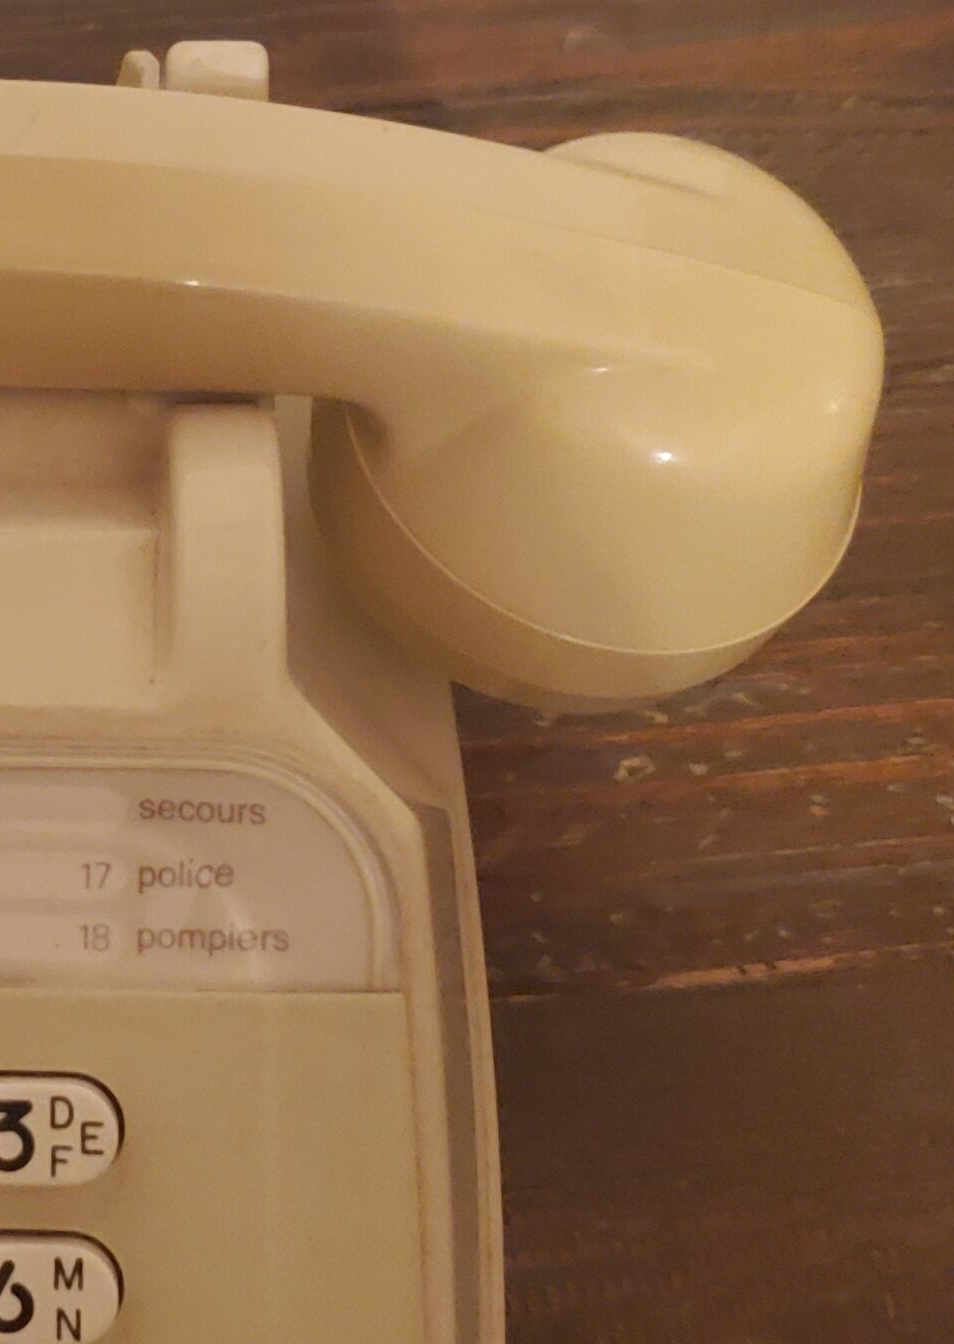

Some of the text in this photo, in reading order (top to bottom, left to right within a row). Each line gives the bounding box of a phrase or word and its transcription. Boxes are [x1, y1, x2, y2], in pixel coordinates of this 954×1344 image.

[137, 798, 266, 825] secours
[82, 859, 235, 894] 17 police
[80, 924, 290, 957] 18 pompiers
